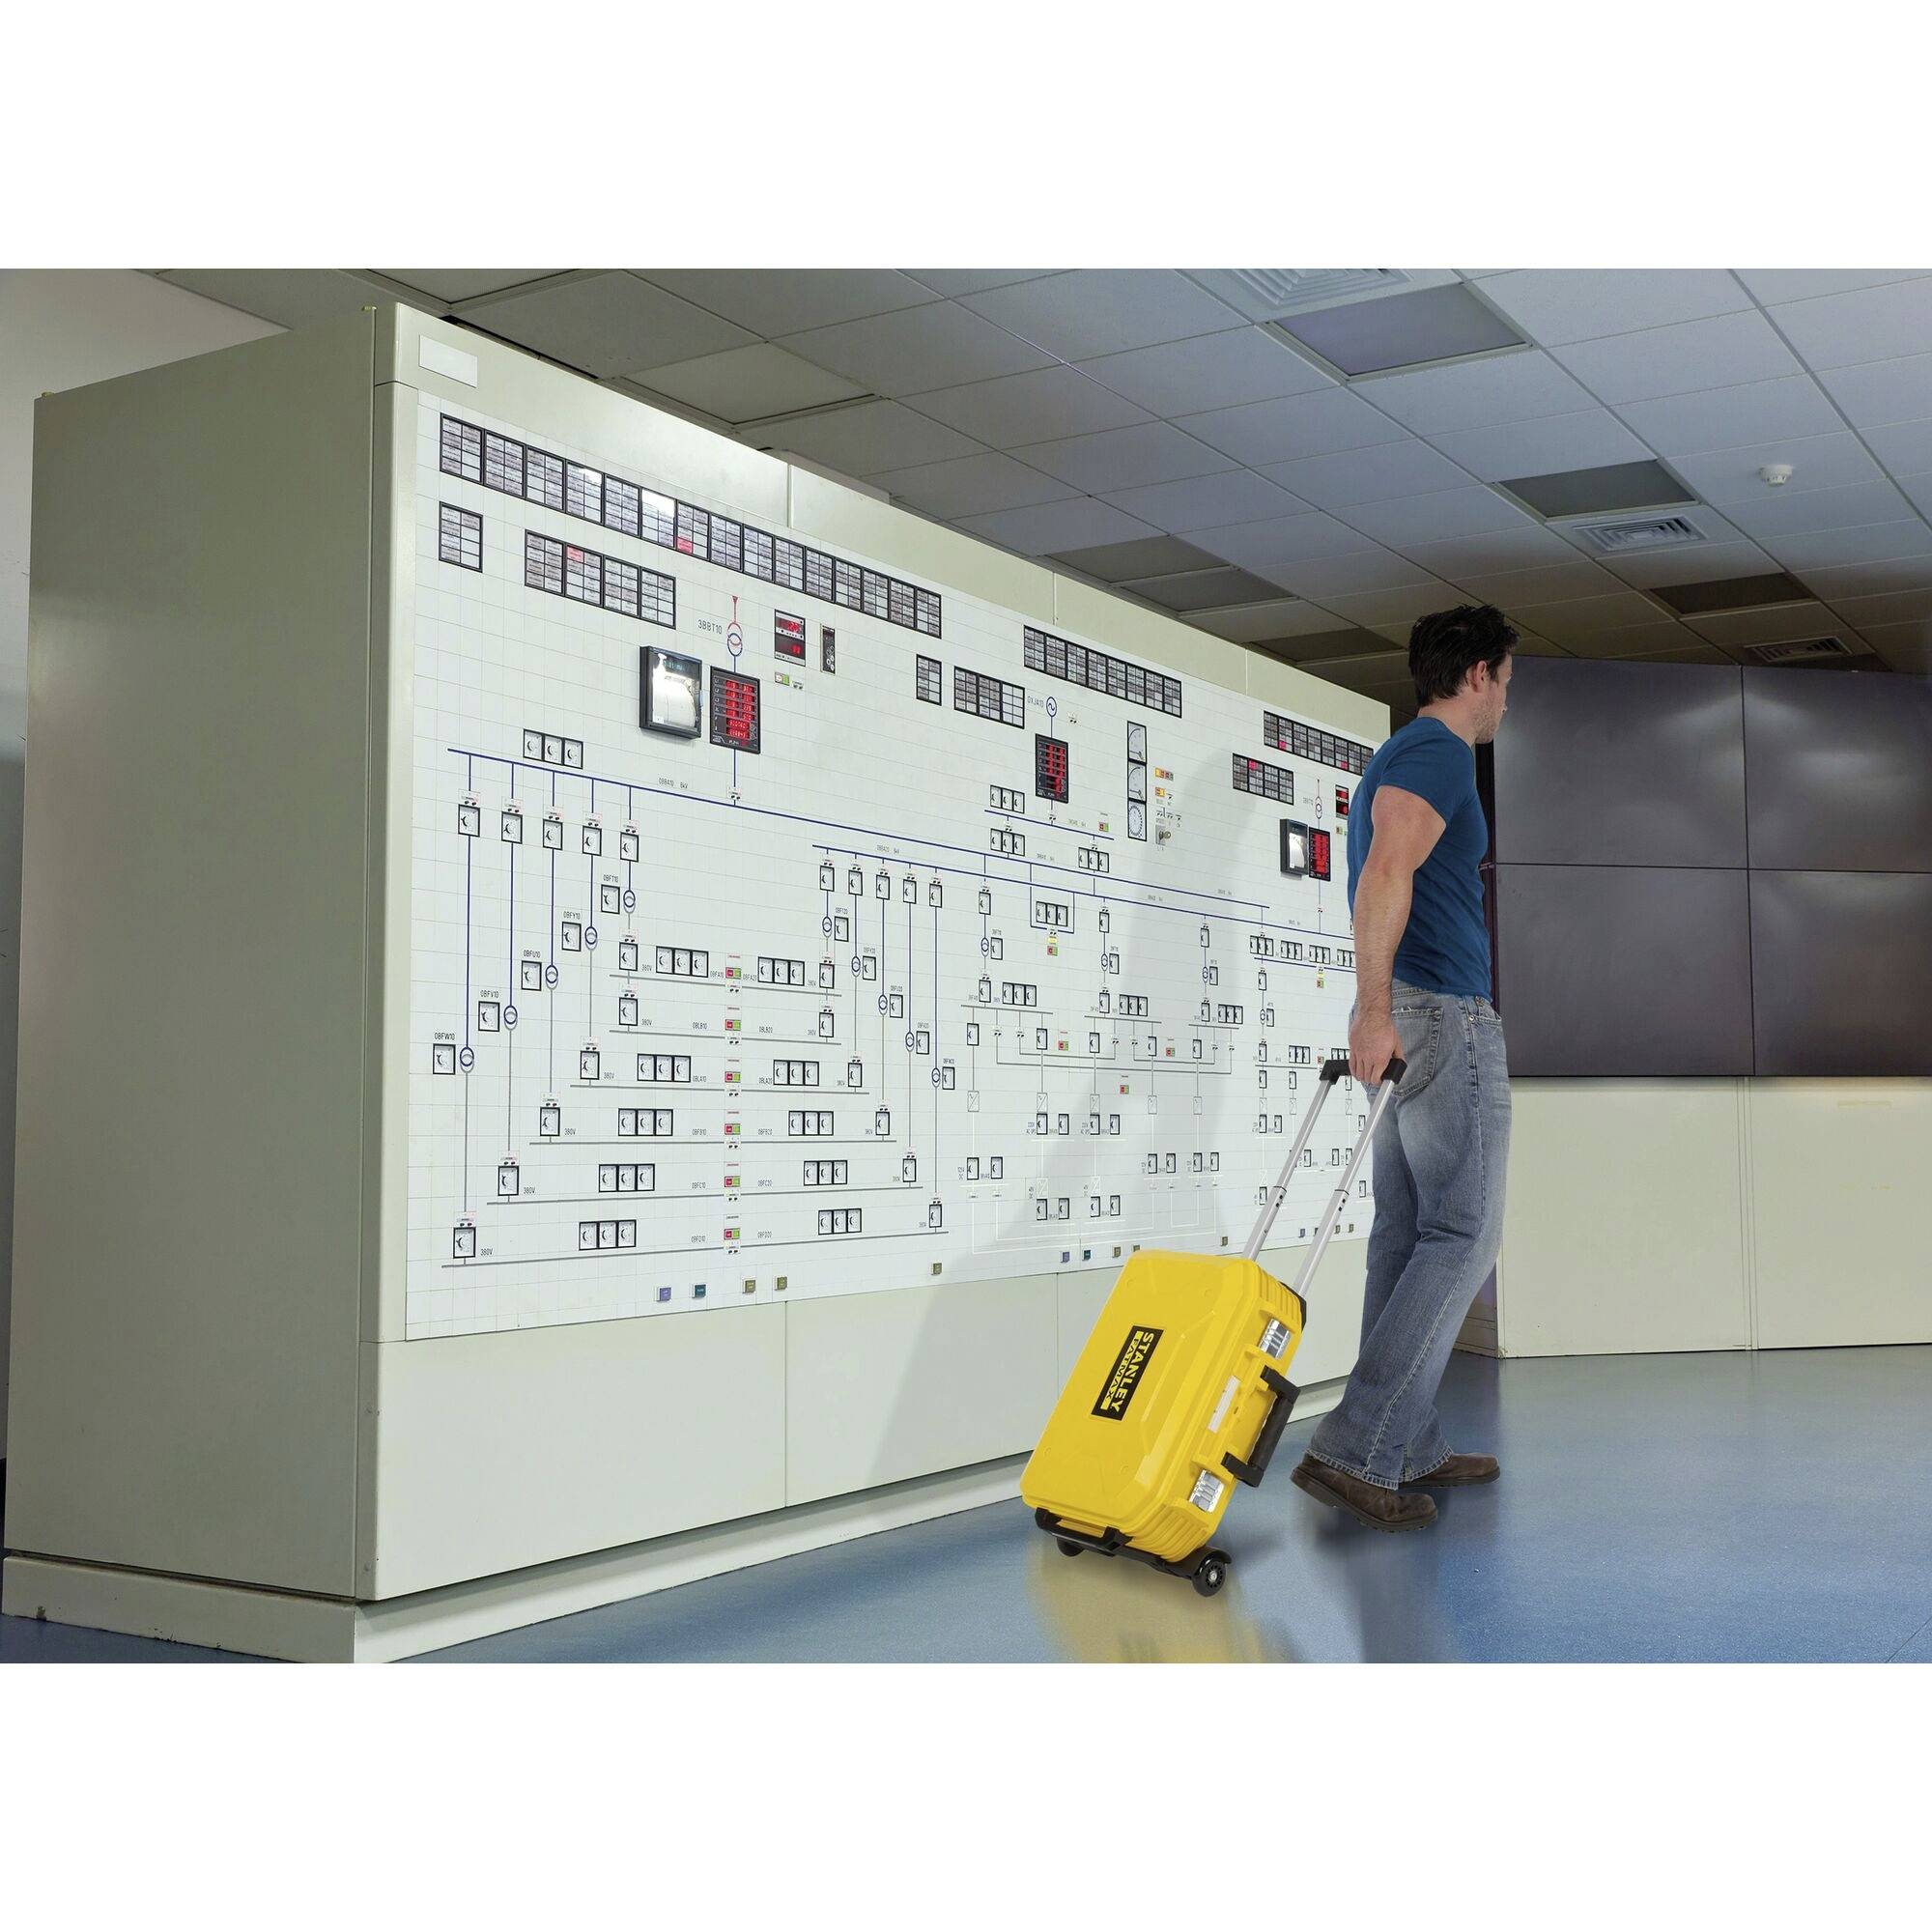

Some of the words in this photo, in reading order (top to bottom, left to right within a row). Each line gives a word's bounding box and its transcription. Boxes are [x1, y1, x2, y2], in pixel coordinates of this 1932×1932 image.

[564, 1127, 577, 1136] 380V
[480, 1247, 494, 1257] 380V
[1105, 1338, 1140, 1400] FATMAX
[1110, 1331, 1155, 1412] STANLEY
